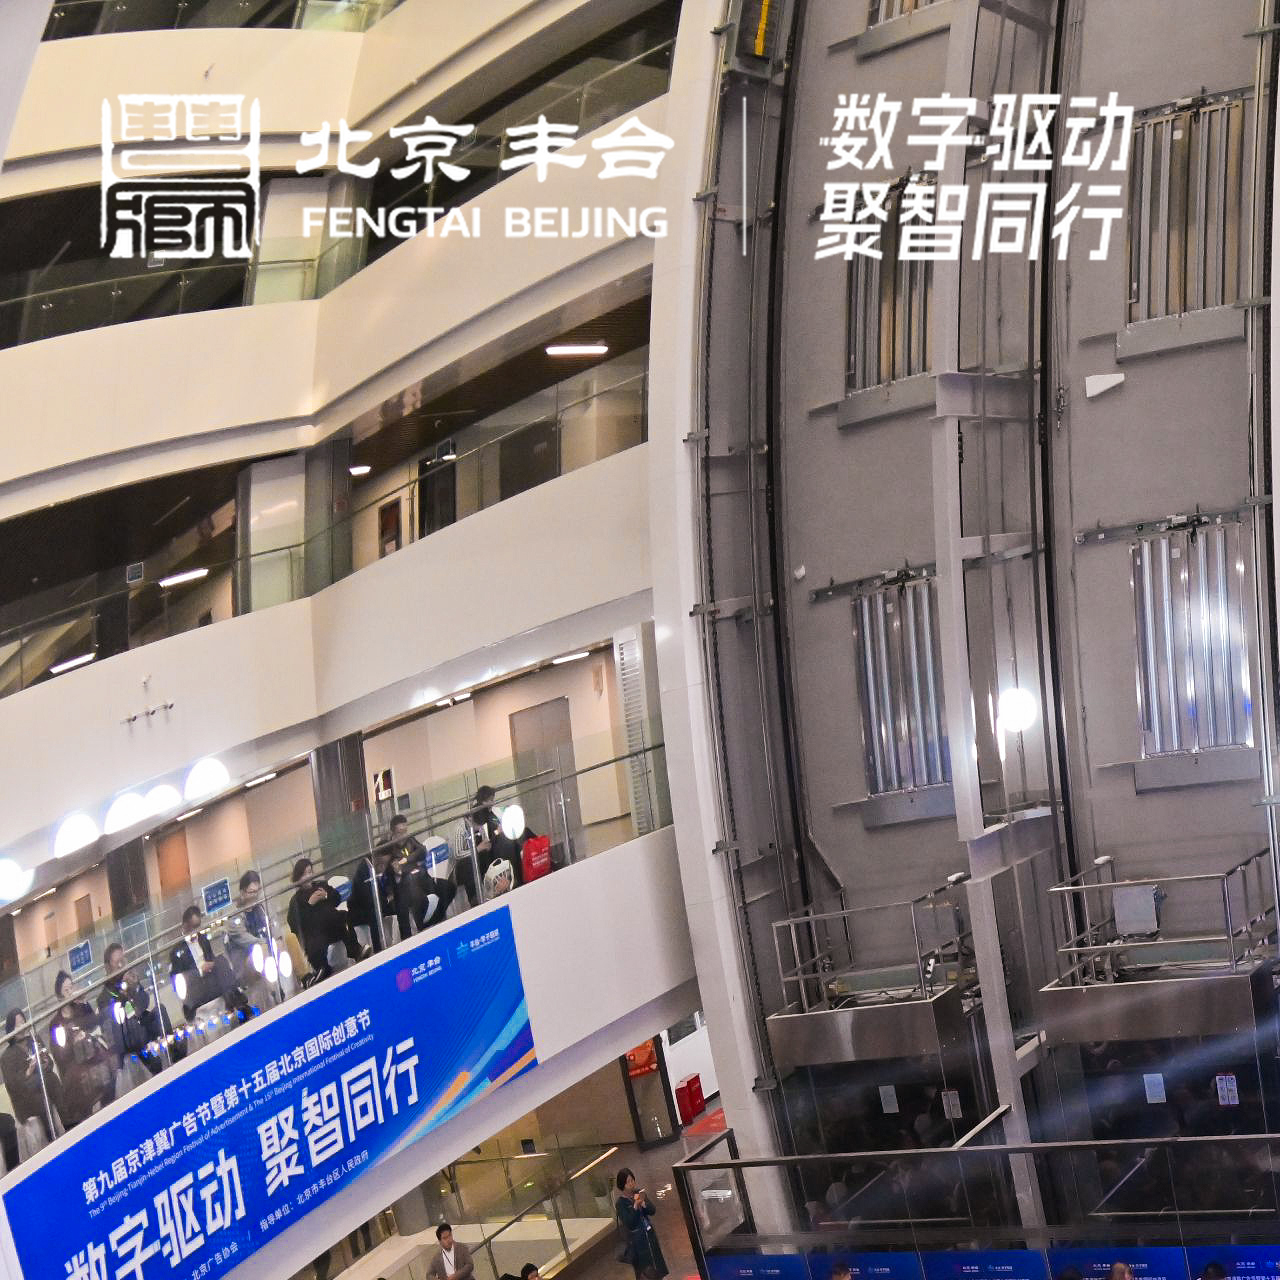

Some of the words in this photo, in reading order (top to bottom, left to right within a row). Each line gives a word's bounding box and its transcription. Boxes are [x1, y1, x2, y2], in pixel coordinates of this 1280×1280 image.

[83, 1008, 372, 1205] 第九届京津冀广告节暨第十五届北京国际创意节
[257, 1037, 420, 1198] 聚智同行
